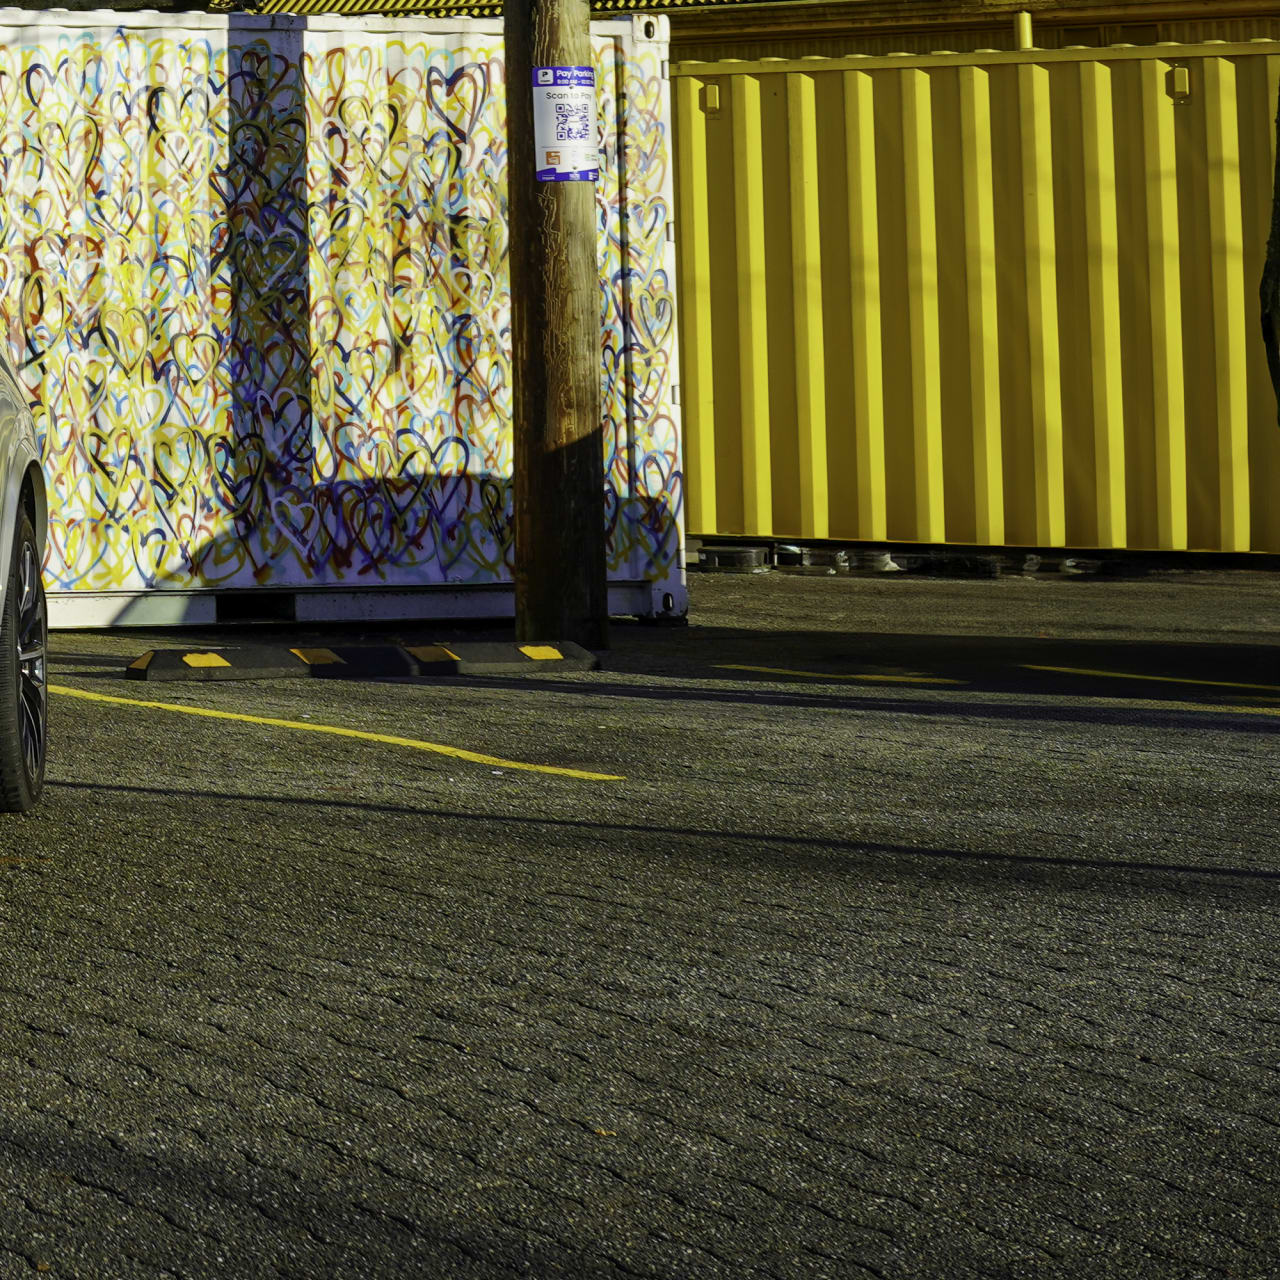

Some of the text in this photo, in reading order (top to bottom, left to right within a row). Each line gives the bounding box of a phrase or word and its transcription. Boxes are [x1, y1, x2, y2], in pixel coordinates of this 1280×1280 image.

[556, 70, 572, 79] Pay
[545, 92, 592, 101] Scan to Pay
